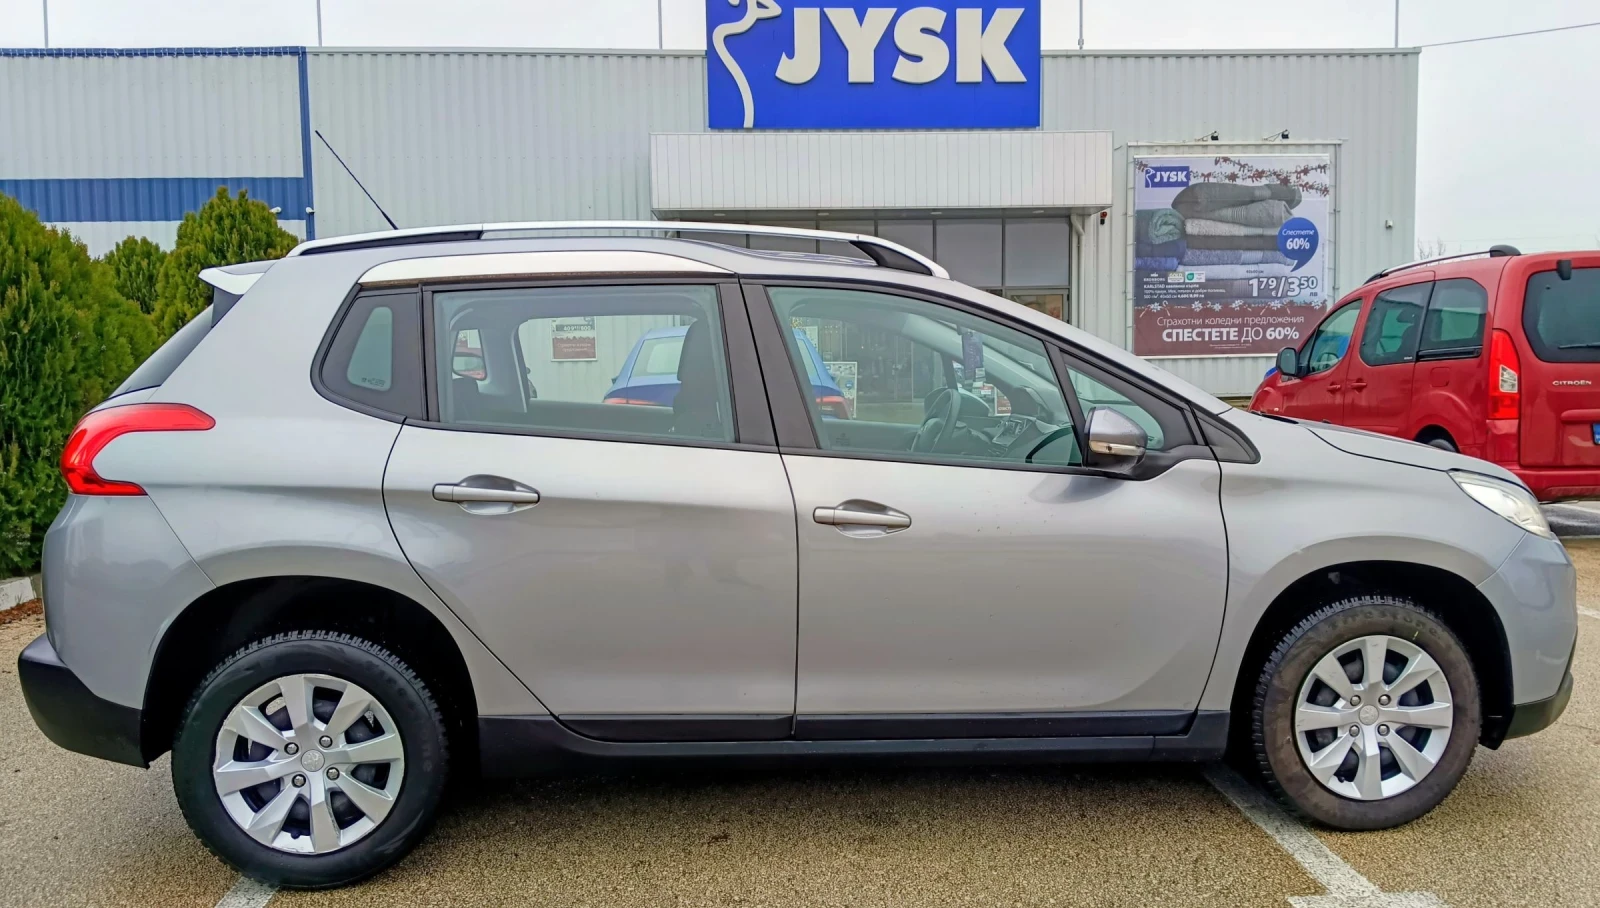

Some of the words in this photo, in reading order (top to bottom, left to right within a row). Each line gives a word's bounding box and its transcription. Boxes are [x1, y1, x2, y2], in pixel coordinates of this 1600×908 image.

[775, 7, 1027, 84] JYSK
[1154, 171, 1187, 182] JYSK
[1286, 238, 1310, 250] 60%
[1157, 317, 1202, 327] Страхотни
[1205, 317, 1241, 325] коледни
[1244, 316, 1304, 326] предложения
[1162, 328, 1239, 341] СПЕСТЕТЕ
[1241, 327, 1263, 342] ДО
[1266, 327, 1299, 339] 60%
